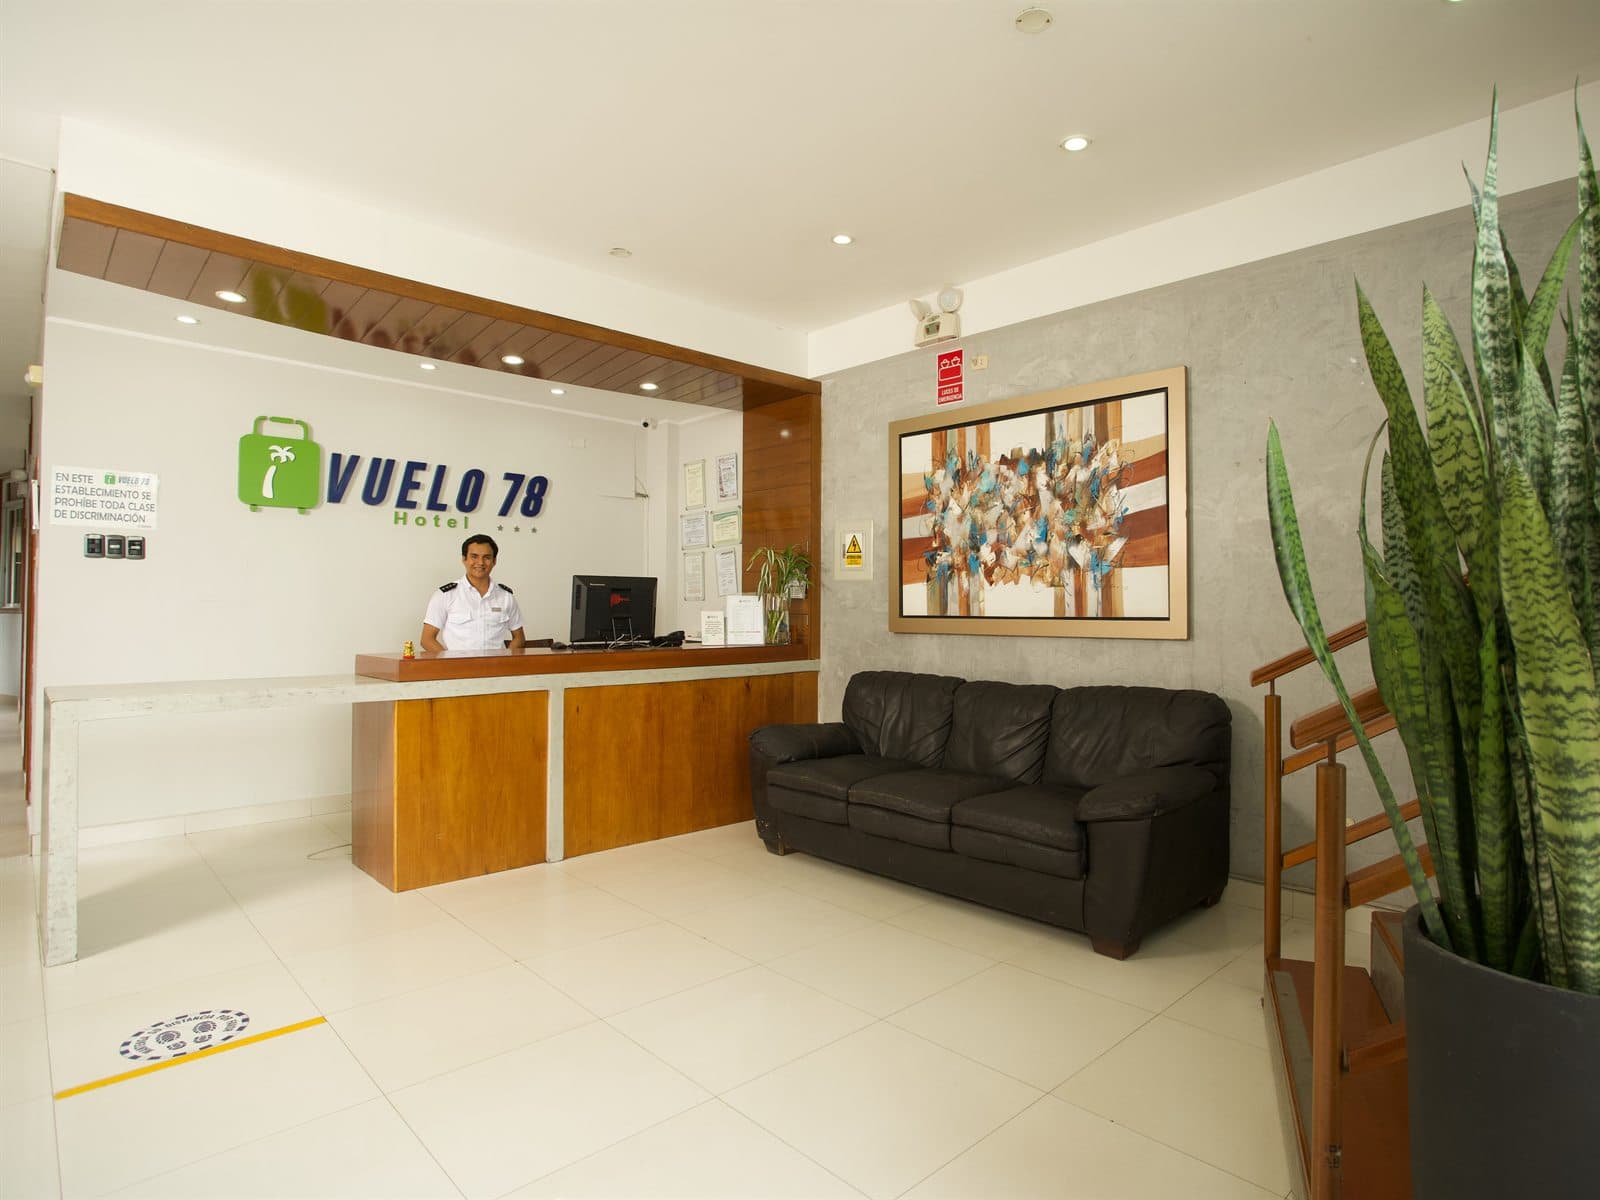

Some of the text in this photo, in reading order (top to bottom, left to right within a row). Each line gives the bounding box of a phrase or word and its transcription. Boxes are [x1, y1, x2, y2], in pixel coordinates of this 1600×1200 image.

[55, 472, 69, 482] EN
[71, 473, 94, 484] ESTE
[118, 475, 139, 485] VUELO
[326, 452, 549, 518] VUELO 78
[55, 485, 152, 501] ESTABLECIMIENTO SE
[99, 500, 125, 510] TODA
[127, 502, 156, 513] CLASE
[54, 509, 146, 523] DE DISCRIMINACIÓN
[393, 511, 470, 530] Hotel
